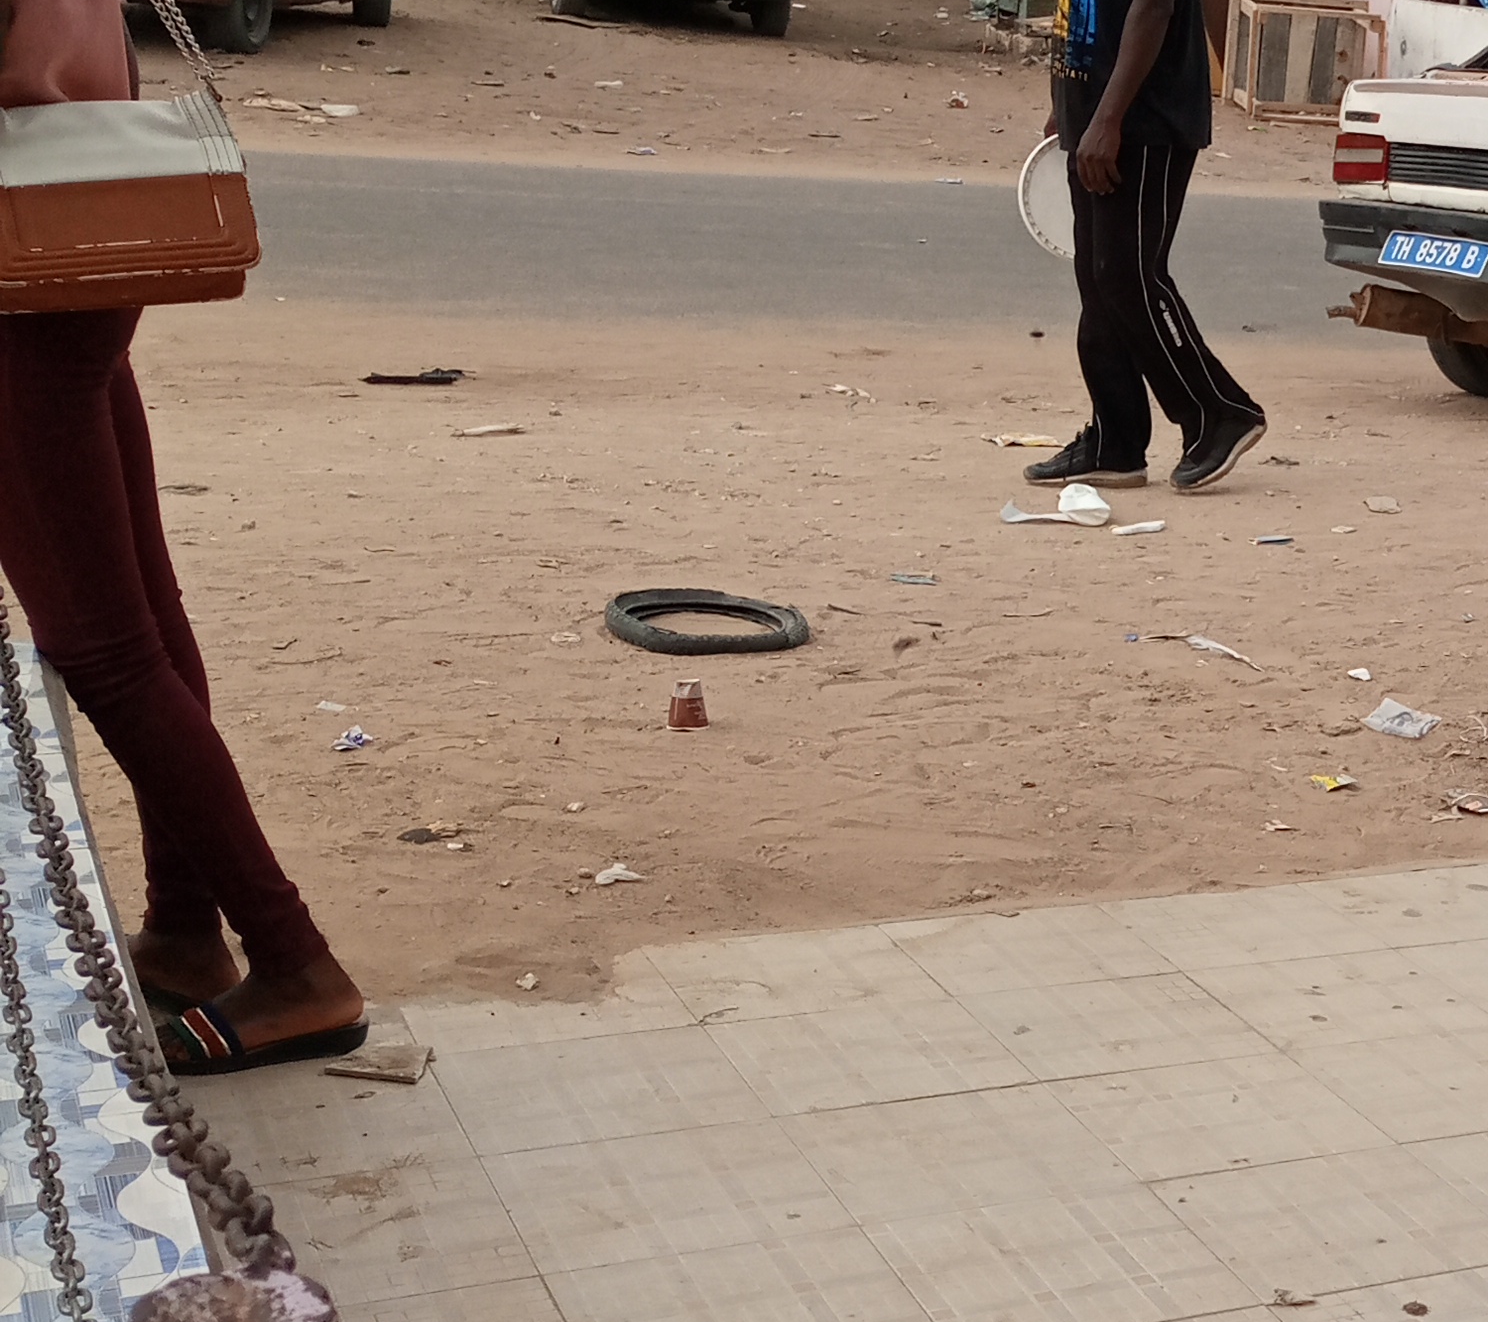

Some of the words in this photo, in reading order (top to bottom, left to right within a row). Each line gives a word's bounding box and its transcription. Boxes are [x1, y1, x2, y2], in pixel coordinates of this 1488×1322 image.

[1391, 236, 1415, 260] TH
[1415, 239, 1461, 267] 8578
[1461, 245, 1480, 269] B
